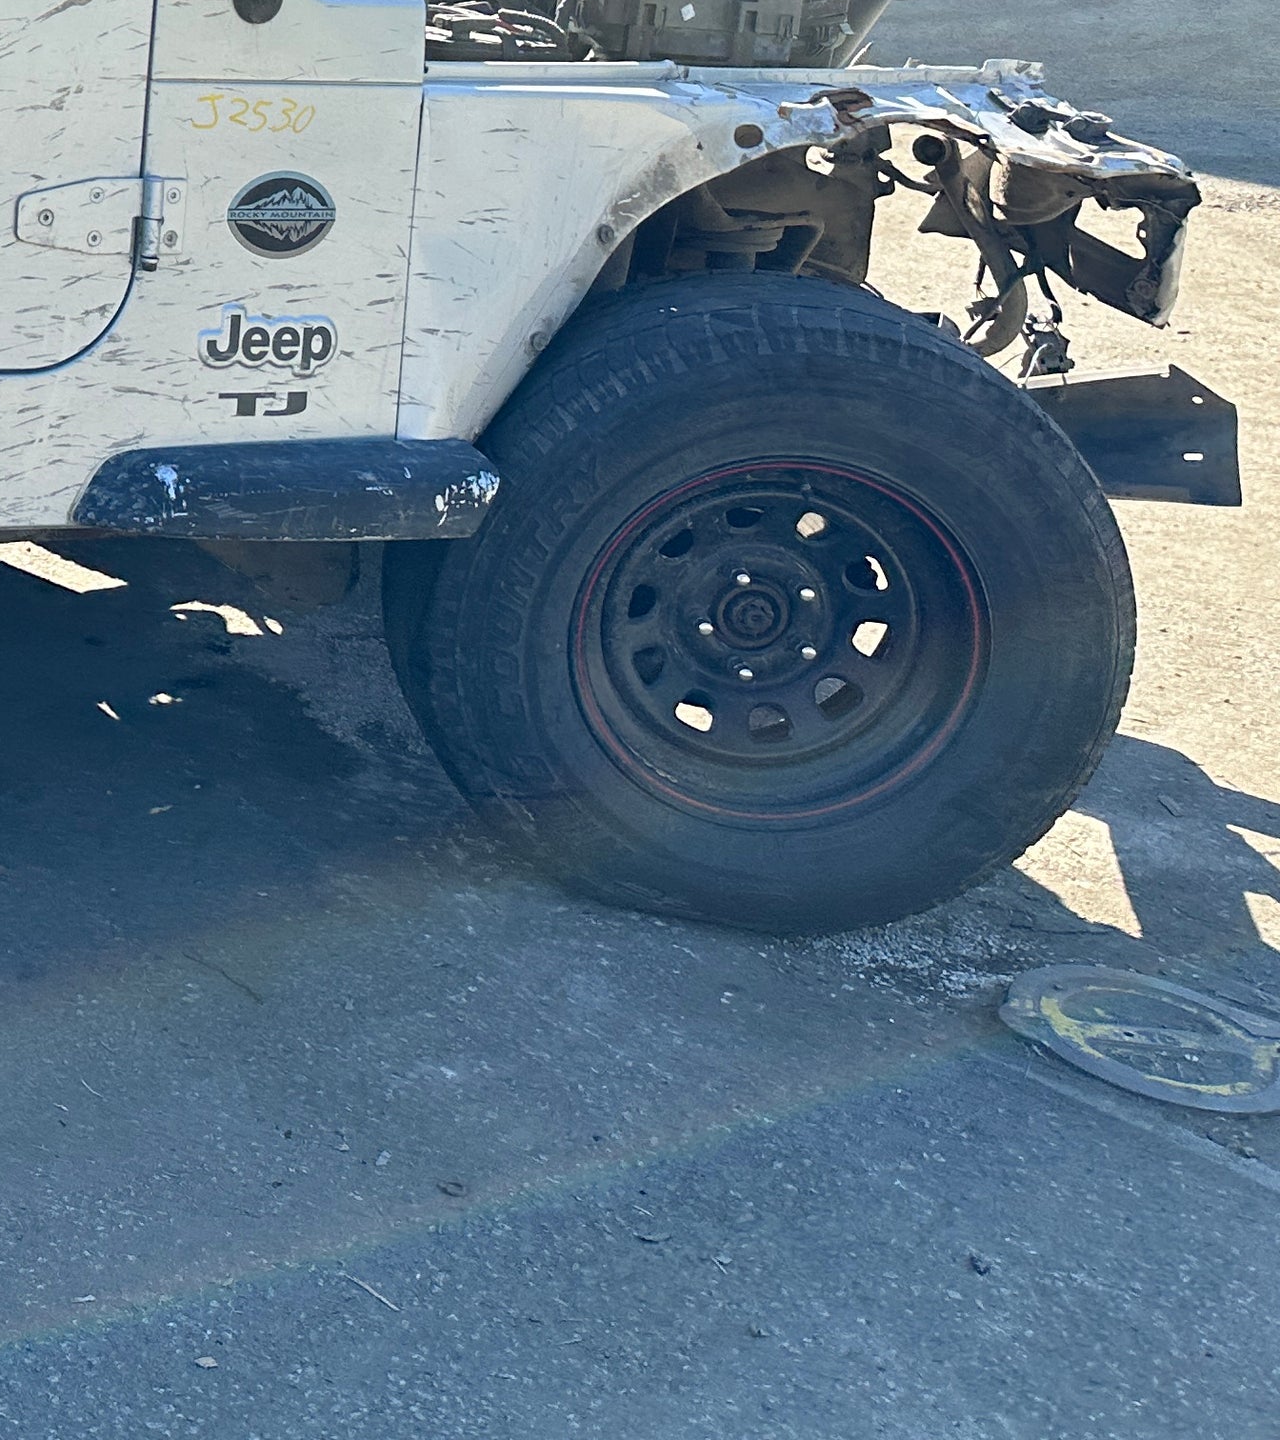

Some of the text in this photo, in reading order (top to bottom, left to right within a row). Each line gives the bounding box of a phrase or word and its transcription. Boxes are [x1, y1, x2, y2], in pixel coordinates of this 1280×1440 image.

[192, 93, 317, 134] J2530
[229, 211, 334, 219] ROCKY MOUNTAIN
[206, 314, 332, 371] Jeep
[218, 391, 308, 417] TJ
